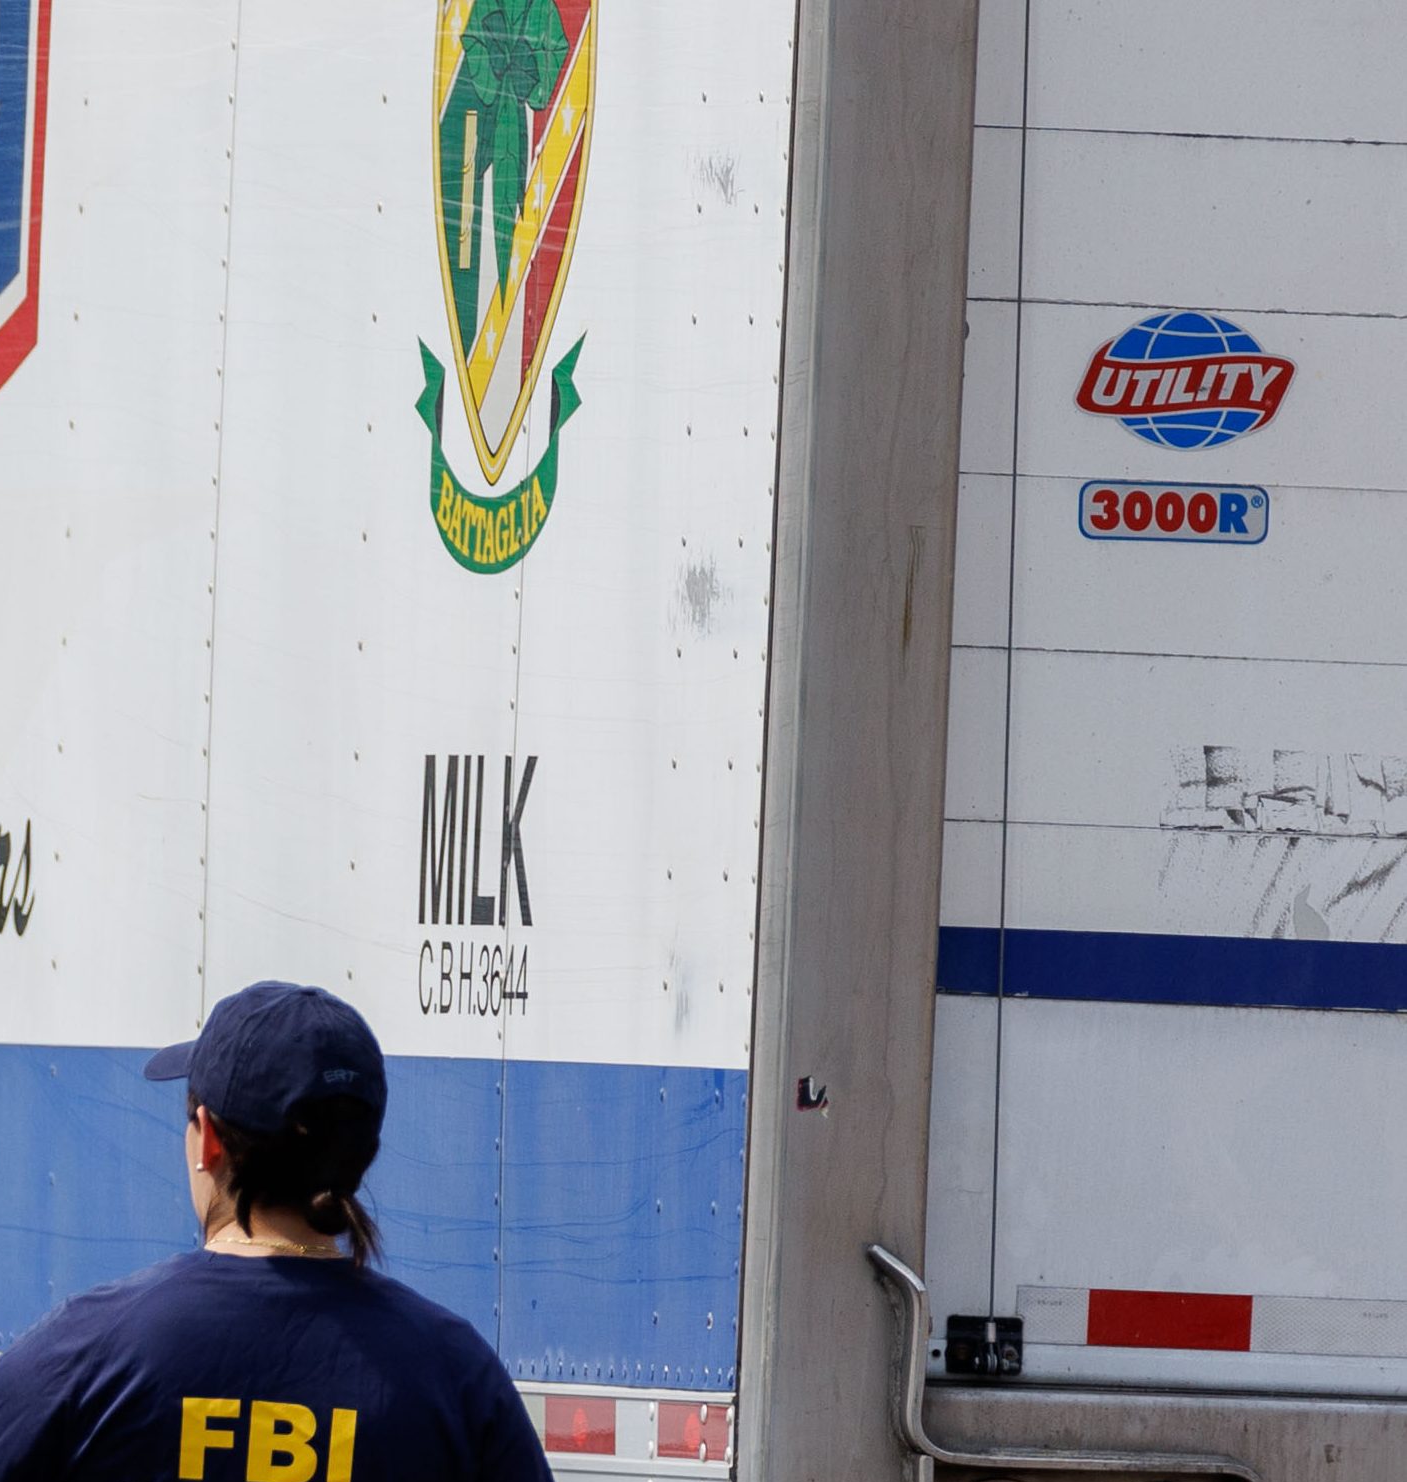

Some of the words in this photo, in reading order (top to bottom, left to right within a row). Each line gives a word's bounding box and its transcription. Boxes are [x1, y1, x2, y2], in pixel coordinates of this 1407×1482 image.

[1091, 362, 1284, 408] UTILITY
[437, 469, 547, 564] BATTAGLIA
[418, 754, 539, 927] MILK
